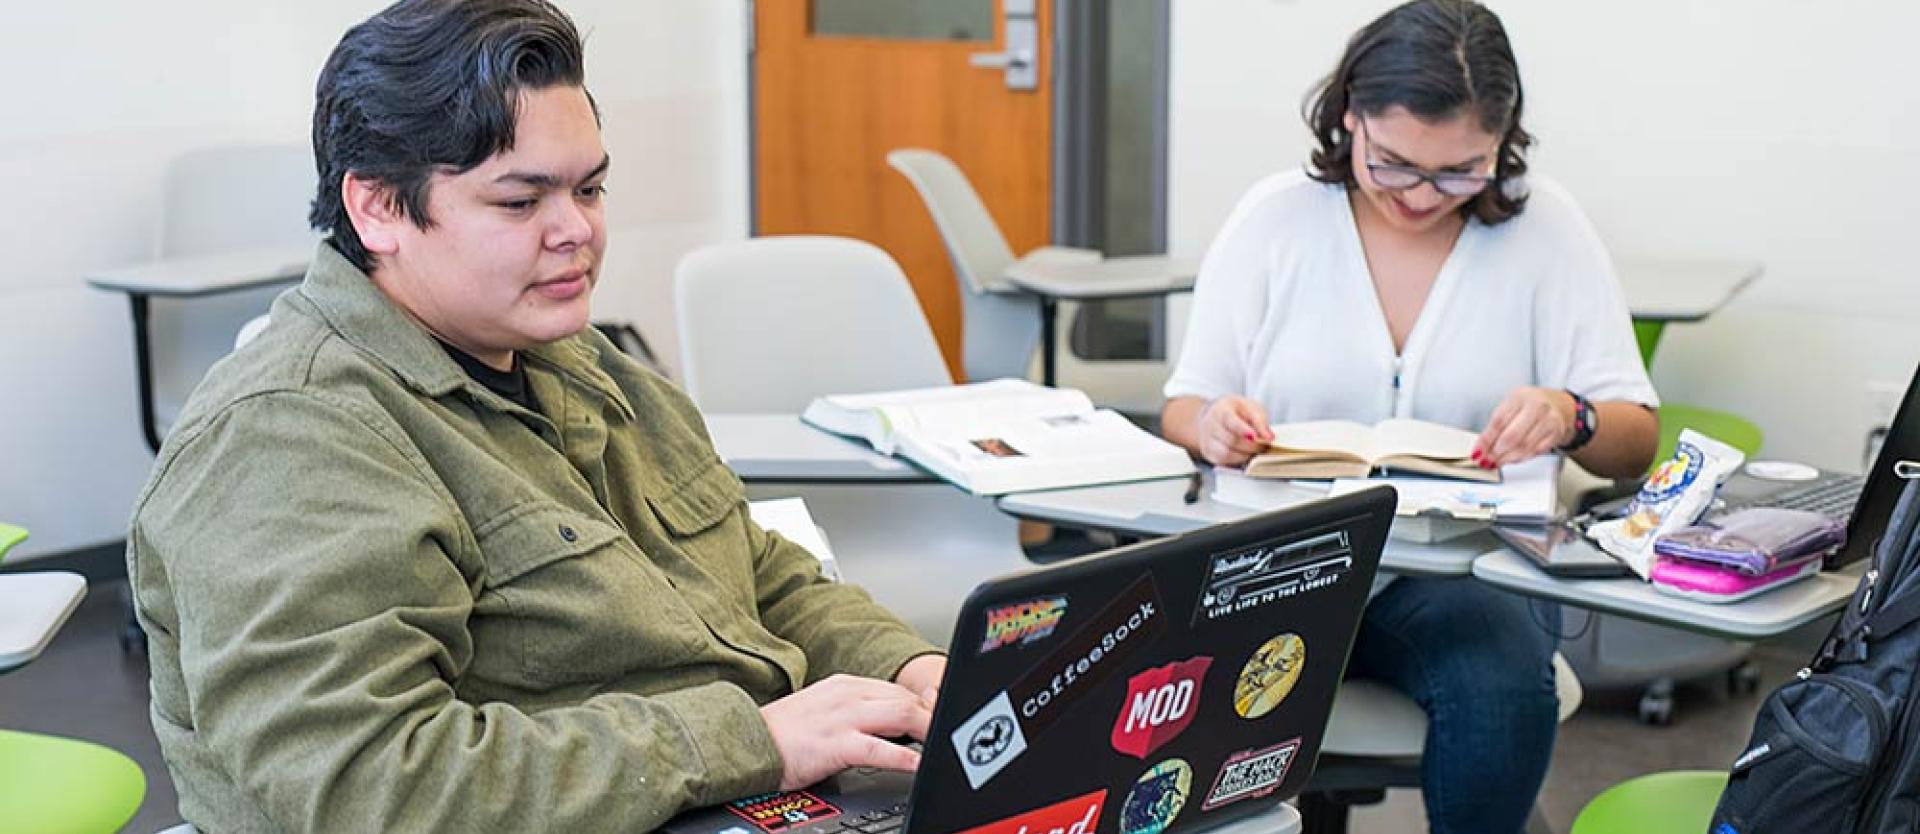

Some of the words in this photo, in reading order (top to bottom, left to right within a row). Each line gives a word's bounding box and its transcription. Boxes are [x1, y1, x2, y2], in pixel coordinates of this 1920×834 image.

[1208, 604, 1232, 619] LIVE
[1261, 592, 1276, 603] TO
[1279, 585, 1297, 599] THE
[1299, 573, 1338, 592] LOWEST
[1022, 602, 1155, 717] CoffeeSock
[1124, 679, 1195, 734] MOD
